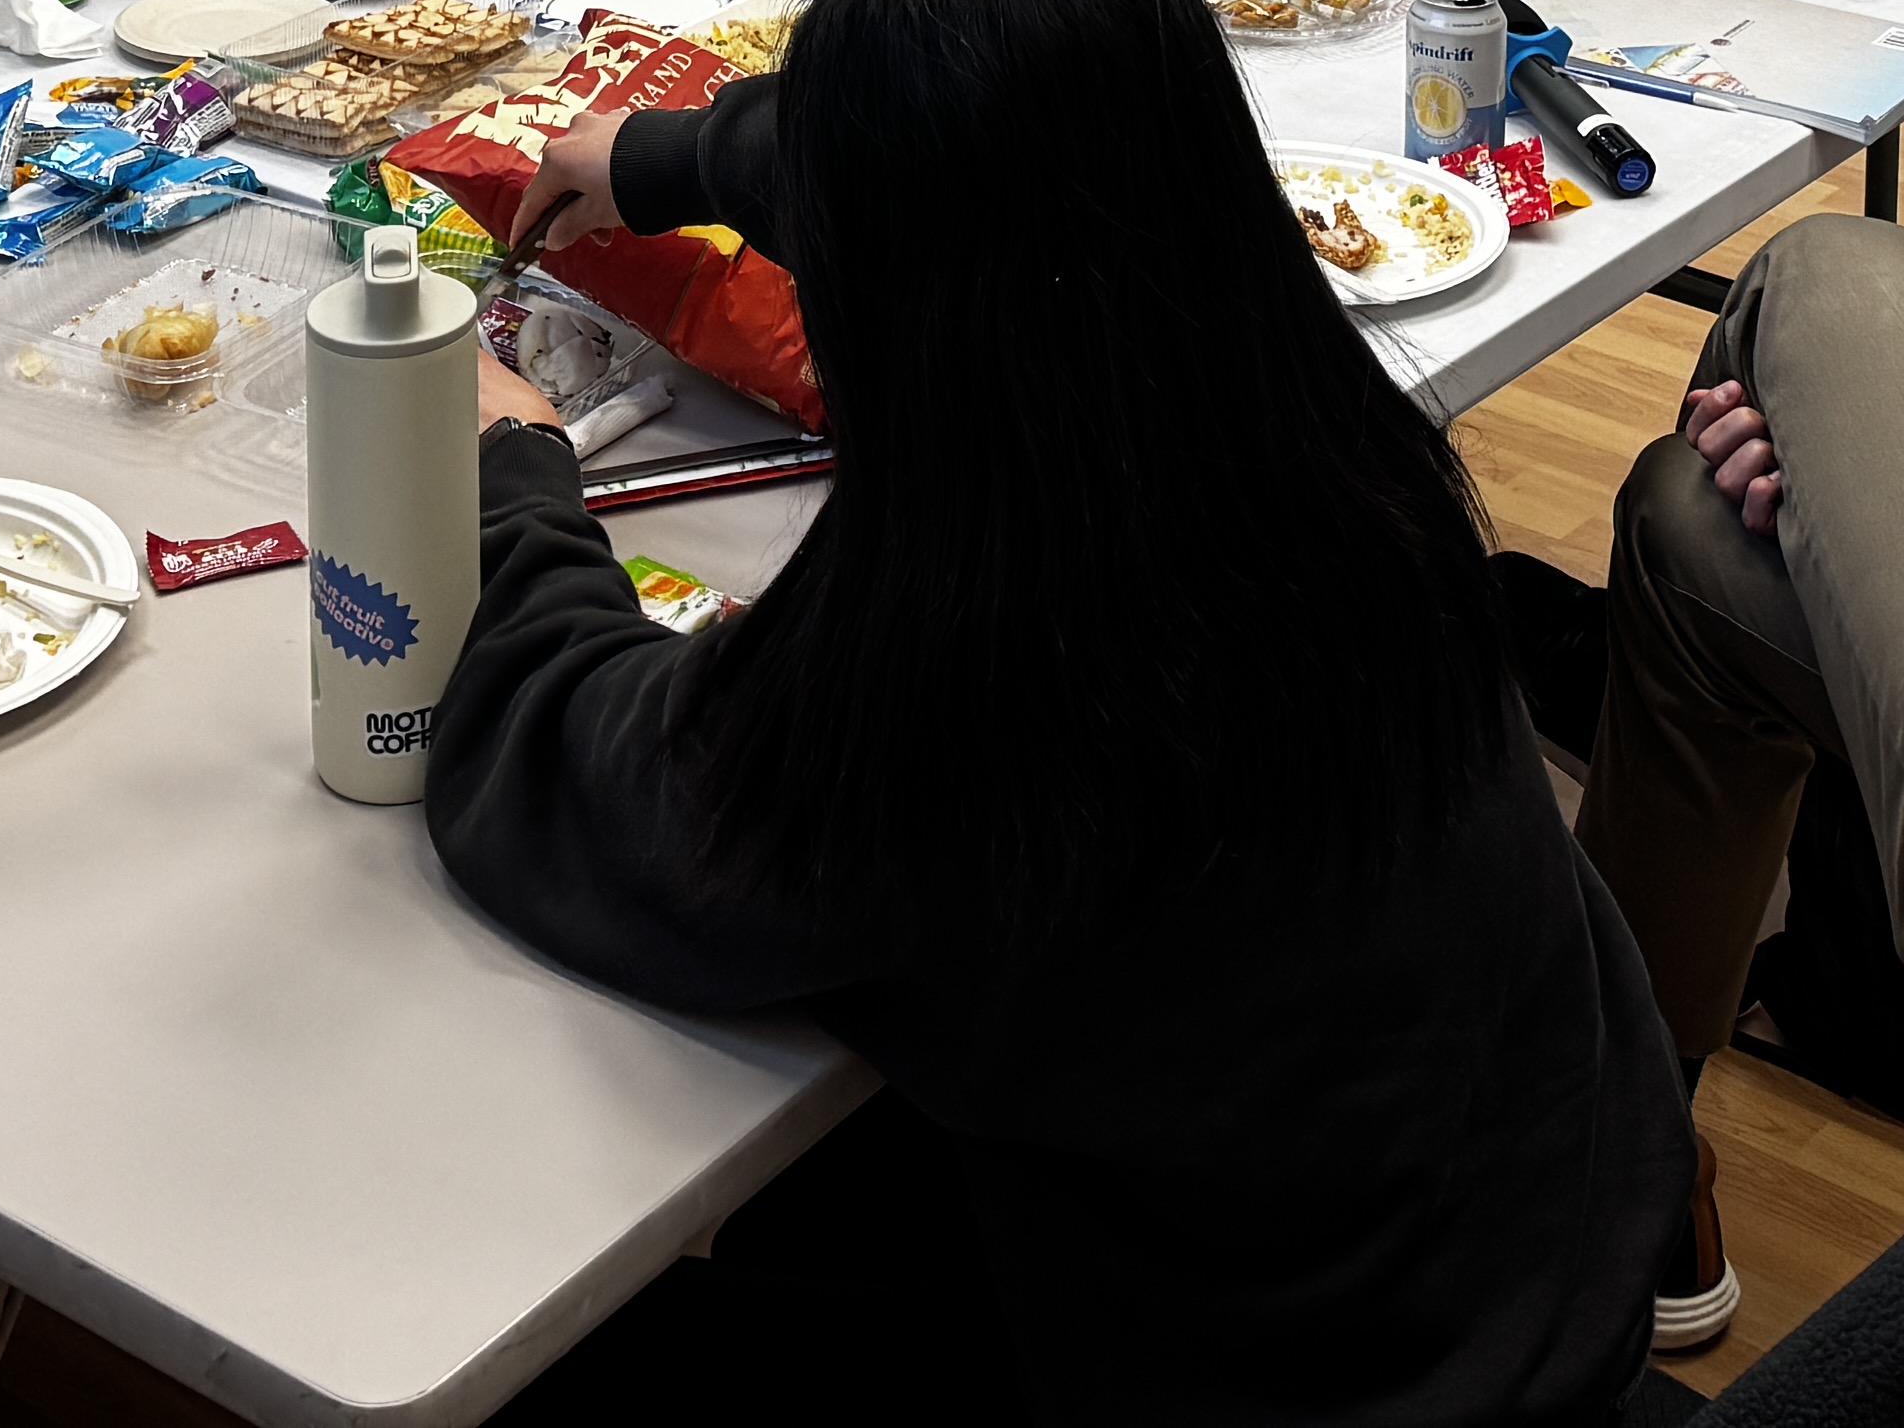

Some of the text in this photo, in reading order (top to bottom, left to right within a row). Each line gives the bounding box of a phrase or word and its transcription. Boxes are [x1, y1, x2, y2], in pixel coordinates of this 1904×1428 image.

[622, 51, 694, 112] RAND
[366, 706, 433, 734] MOT
[366, 730, 432, 755] COFF
